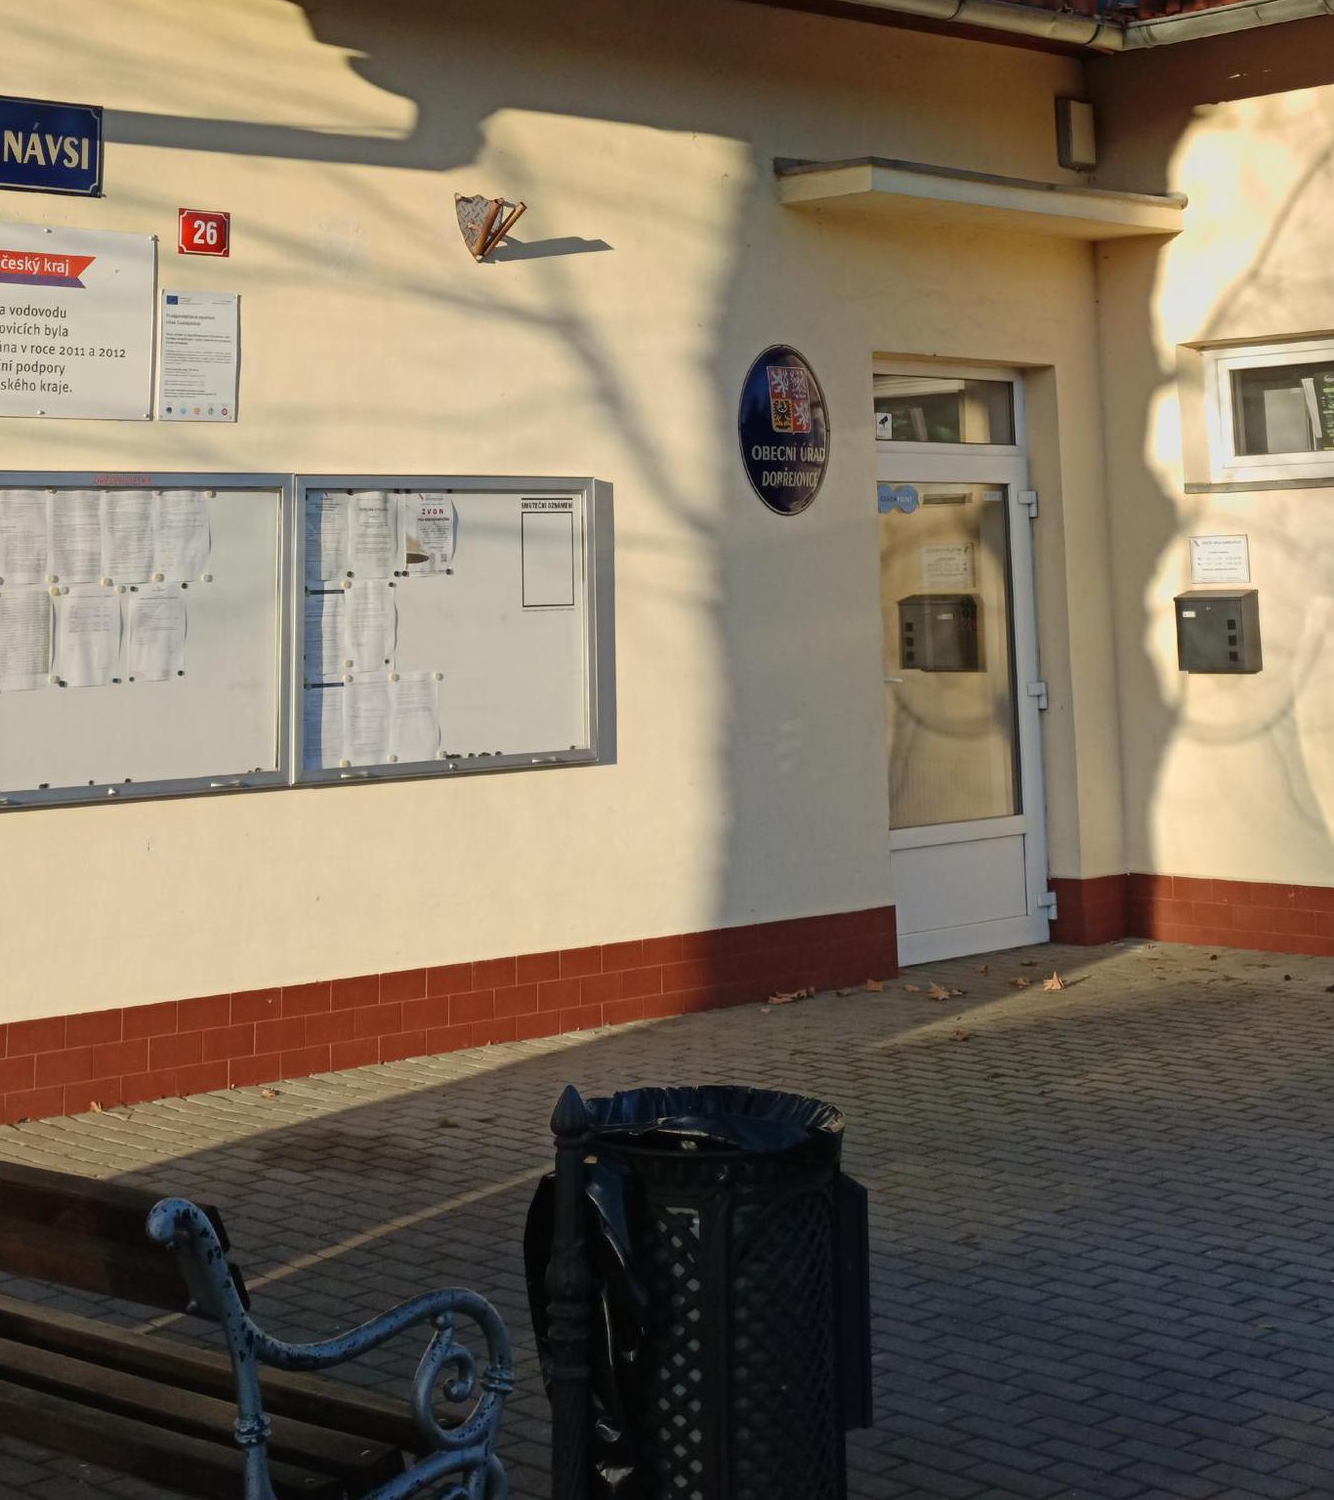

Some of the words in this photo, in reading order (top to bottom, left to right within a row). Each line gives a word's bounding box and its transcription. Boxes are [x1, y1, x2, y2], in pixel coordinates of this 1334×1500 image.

[3, 122, 89, 170] NÁVSI
[193, 220, 217, 245] 26
[44, 260, 69, 276] kraj
[10, 305, 67, 319] vodovodu
[45, 324, 69, 339] byla
[21, 345, 27, 354] v
[30, 344, 56, 355] roce
[59, 346, 85, 357] 2011
[89, 348, 95, 357] a
[99, 348, 126, 358] 2012
[16, 360, 66, 376] podpory
[40, 379, 73, 395] kraje.
[752, 442, 797, 462] OBECNÍ
[800, 442, 825, 462] ÚŘAD
[762, 468, 819, 487] DOBŘEJOVICE
[421, 508, 444, 516] ZVON
